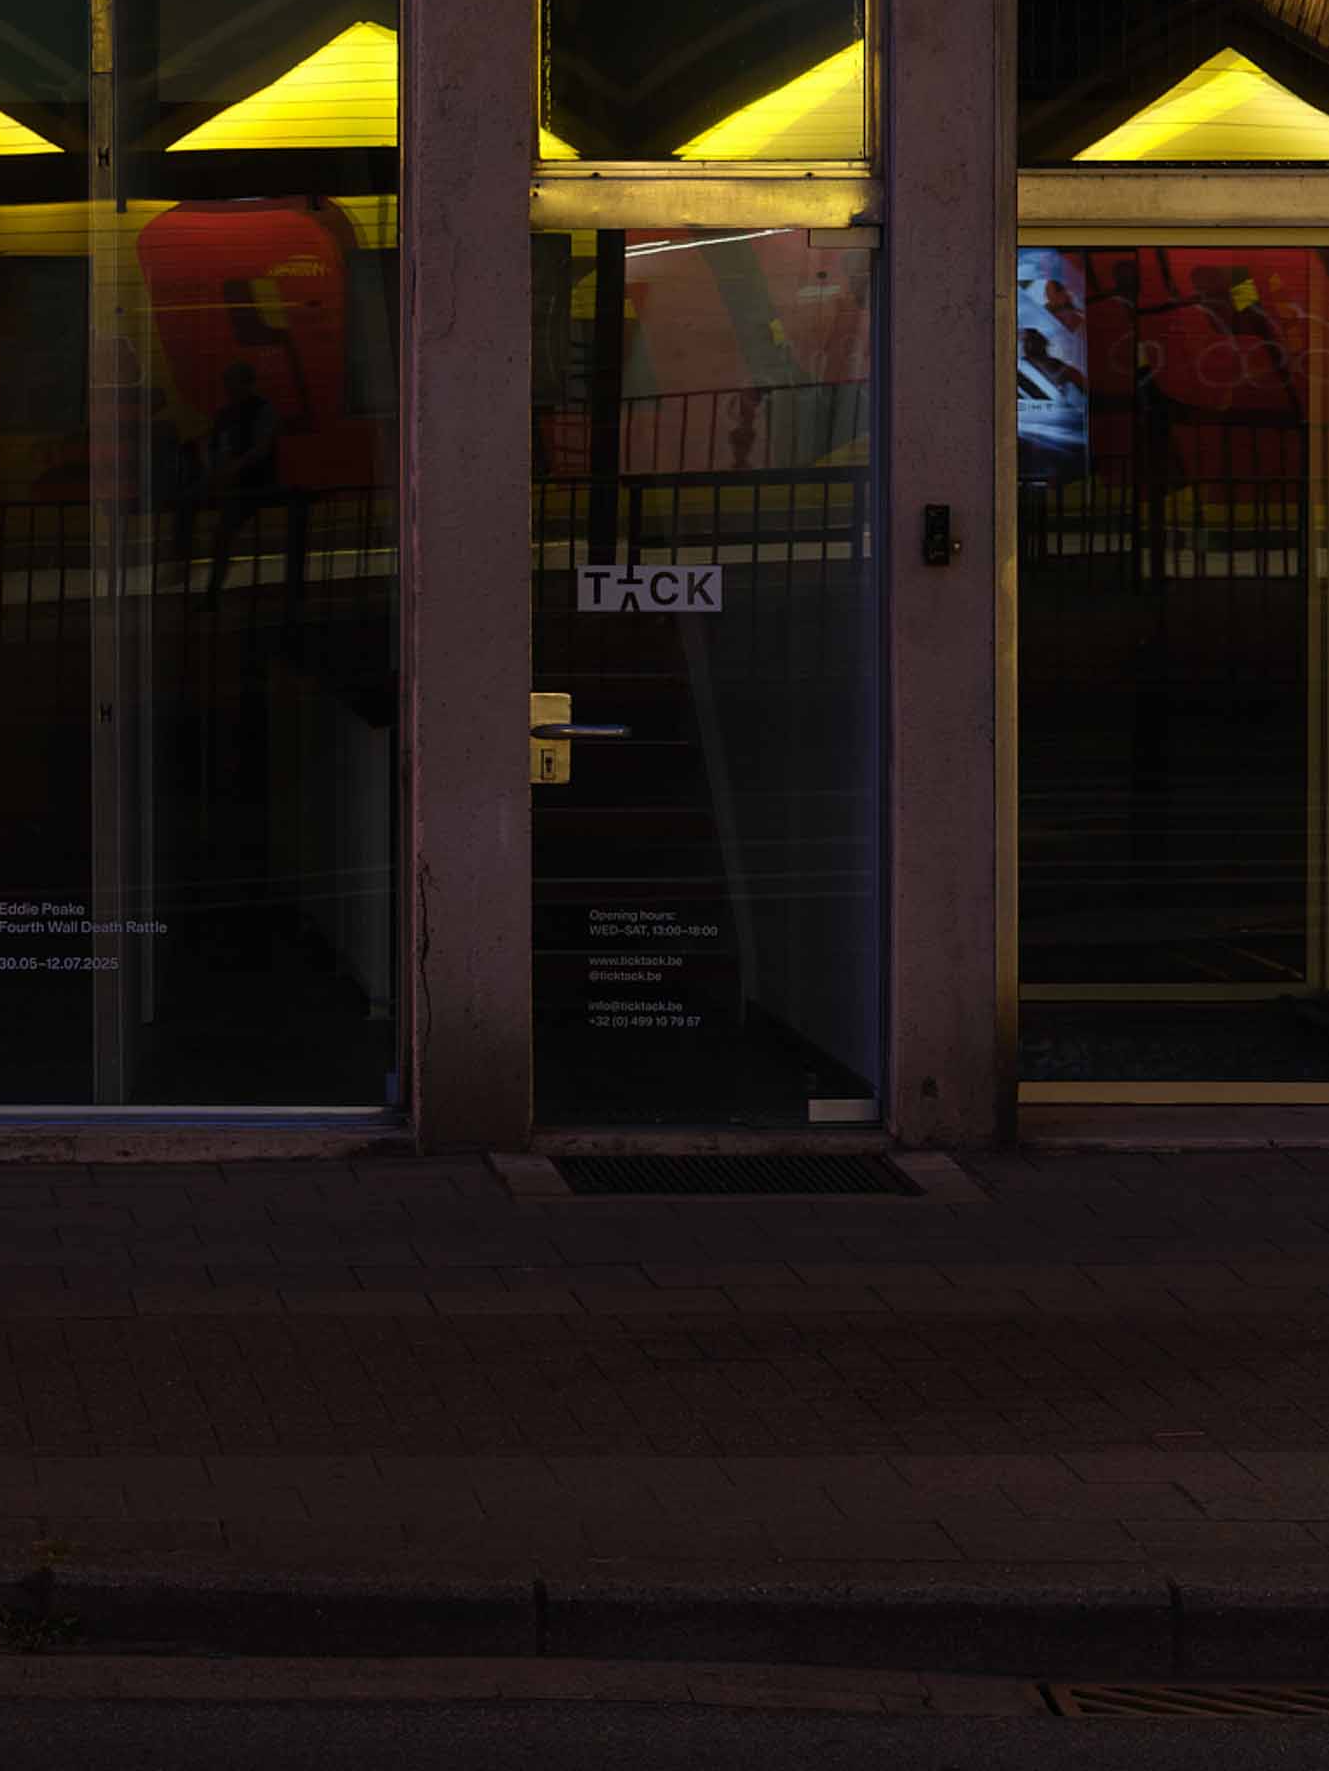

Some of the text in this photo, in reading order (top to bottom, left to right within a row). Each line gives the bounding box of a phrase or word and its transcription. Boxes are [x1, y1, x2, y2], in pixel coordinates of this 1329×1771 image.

[41, 901, 85, 916] Peake
[589, 909, 638, 923] Opening
[47, 919, 78, 934] Wall
[80, 919, 123, 934] Death
[125, 919, 169, 934] Rattle
[588, 955, 683, 966] www.ticktack.be
